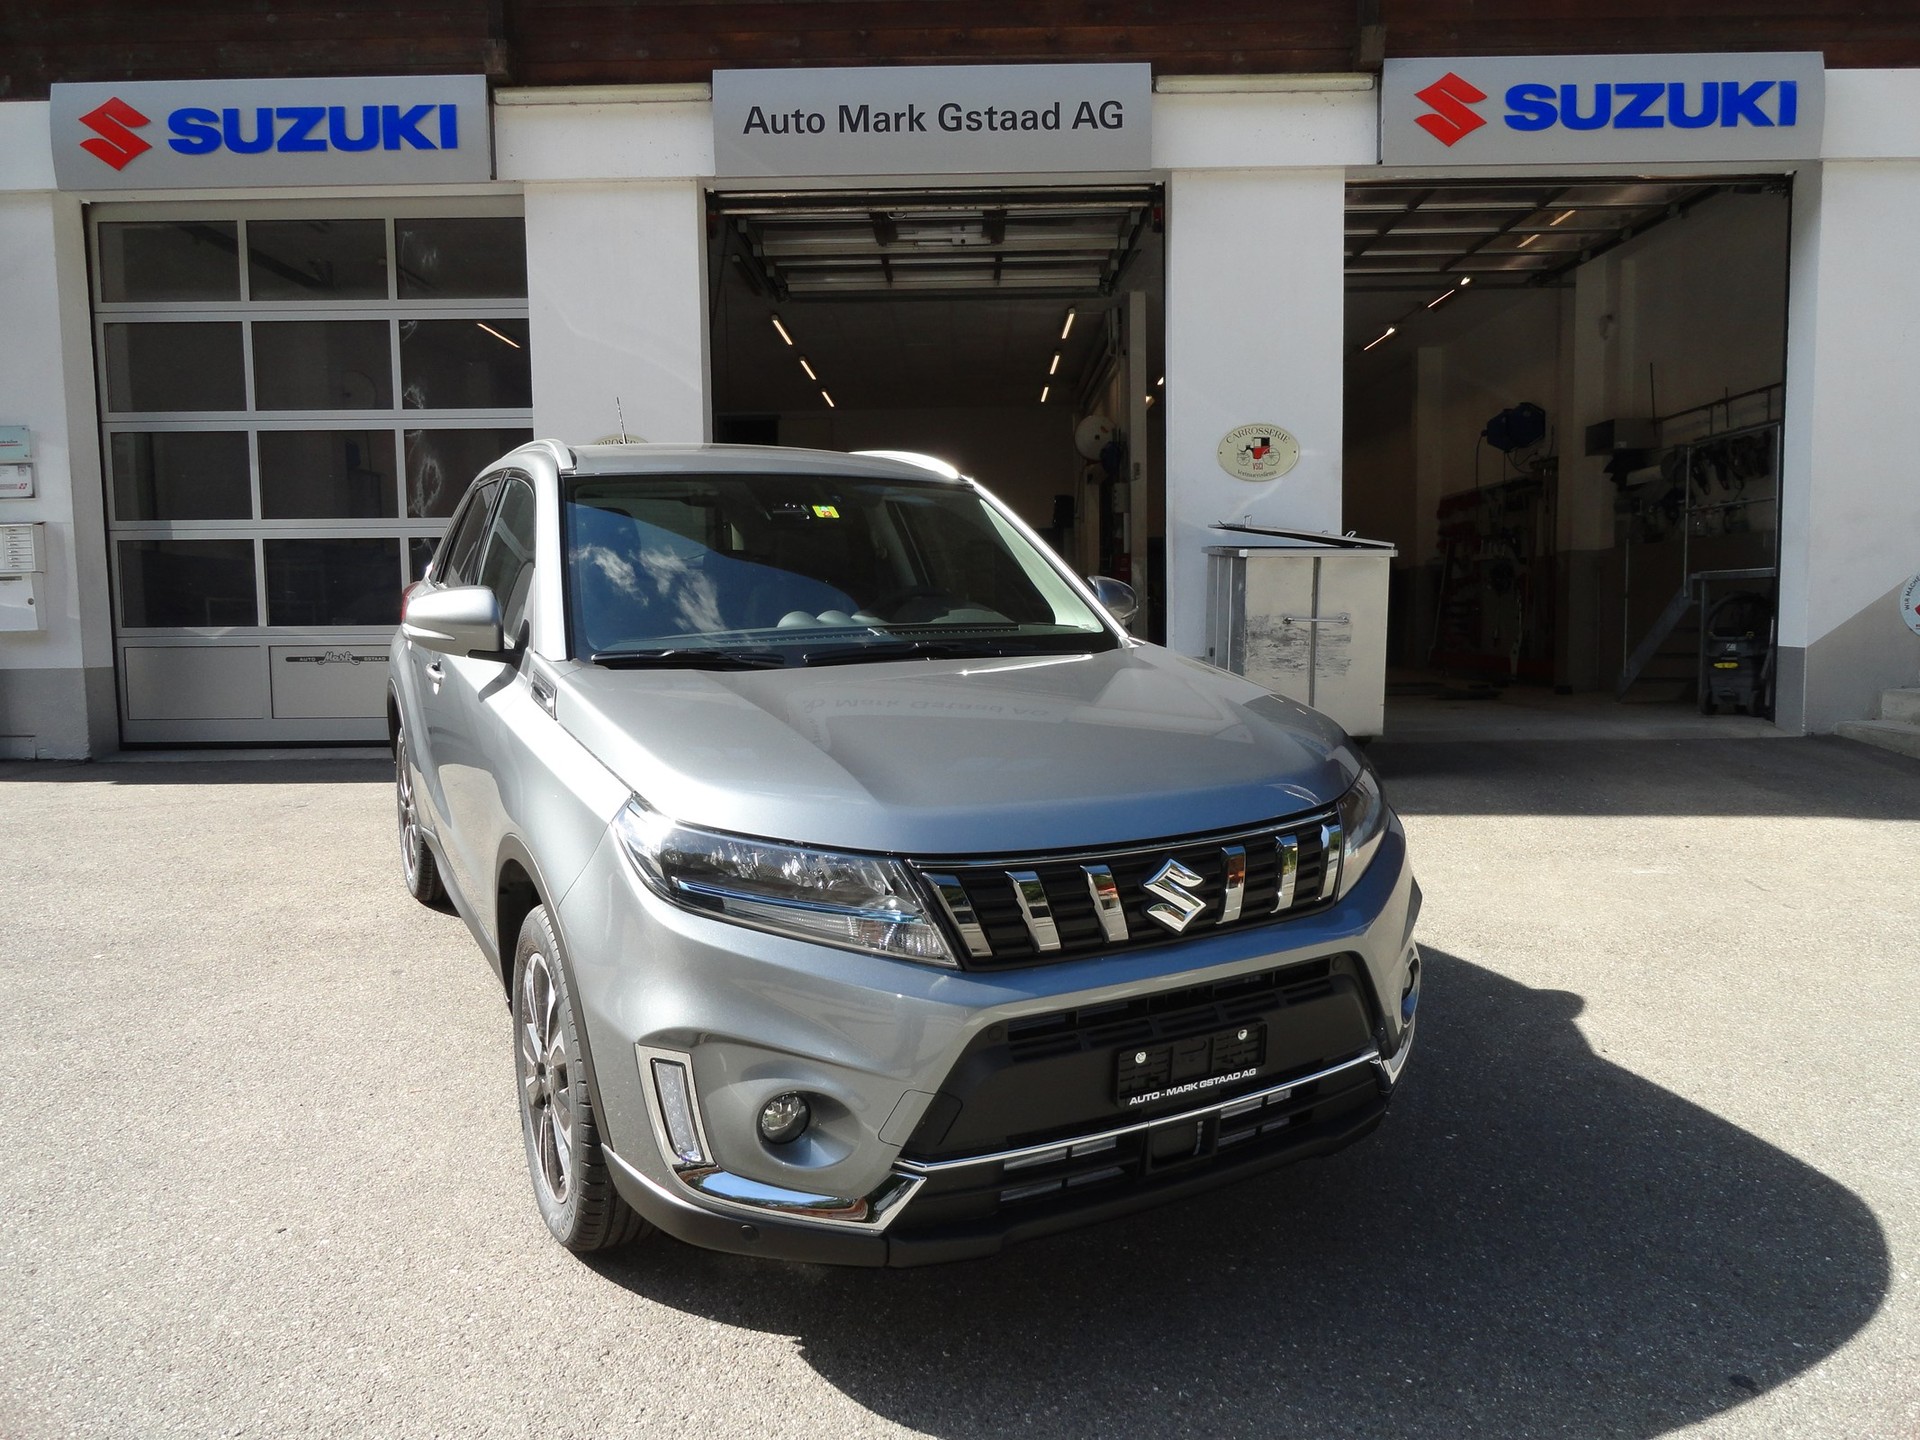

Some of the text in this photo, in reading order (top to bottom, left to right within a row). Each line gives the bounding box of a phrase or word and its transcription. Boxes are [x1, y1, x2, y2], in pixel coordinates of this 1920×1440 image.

[743, 100, 1125, 135] Auto Mark Gstaad AG
[1504, 80, 1797, 131] SUZUKI
[166, 103, 457, 155] SUZUKI
[1226, 427, 1290, 444] CARROSSERIE
[317, 651, 360, 665] Mark
[1129, 1091, 1160, 1105] AUTO
[1166, 1081, 1198, 1097] MARK
[1199, 1072, 1241, 1088] GSTAAD
[1242, 1068, 1256, 1078] AG
